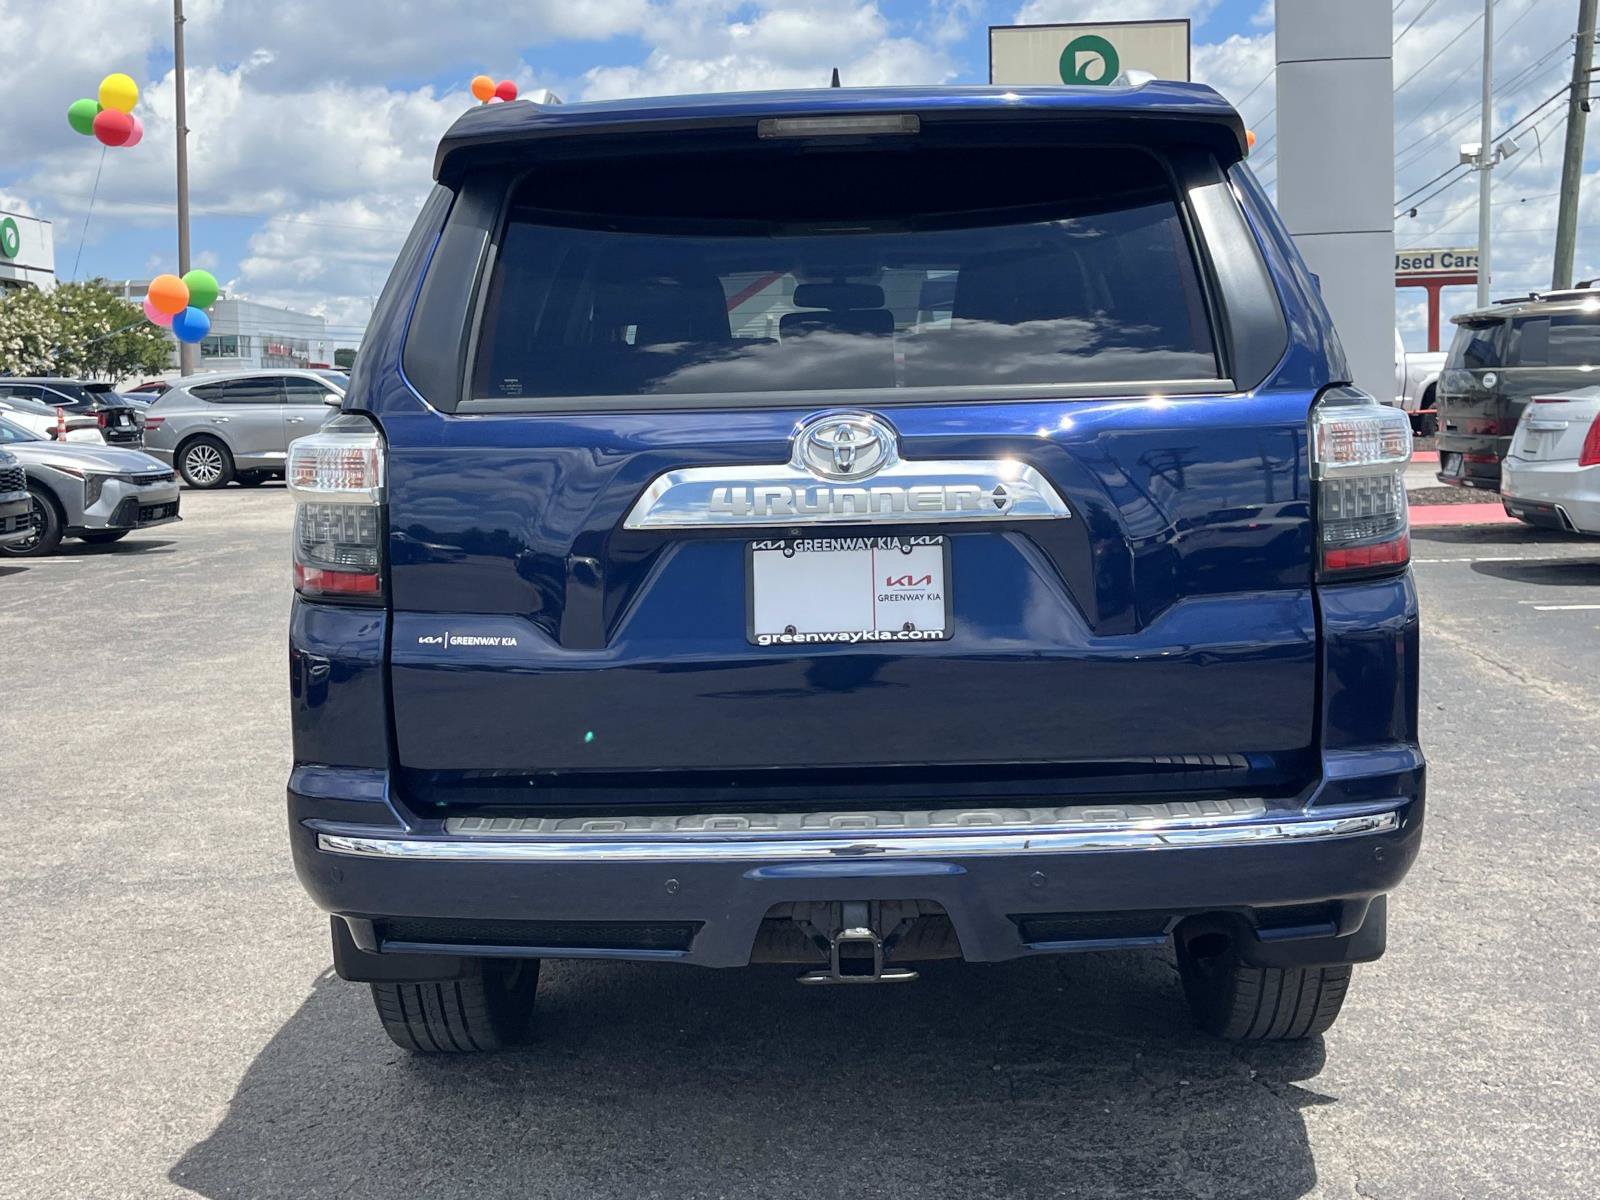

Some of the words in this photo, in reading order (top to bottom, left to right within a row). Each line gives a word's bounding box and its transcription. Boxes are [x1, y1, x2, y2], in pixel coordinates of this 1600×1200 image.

[793, 537, 873, 552] GREENWAY
[877, 536, 902, 550] KIA
[877, 594, 924, 602] GREENWAY
[926, 593, 941, 601] KIA
[449, 636, 501, 646] GREENWAY
[501, 637, 518, 646] KIA
[757, 629, 944, 646] greenwaykia.com
